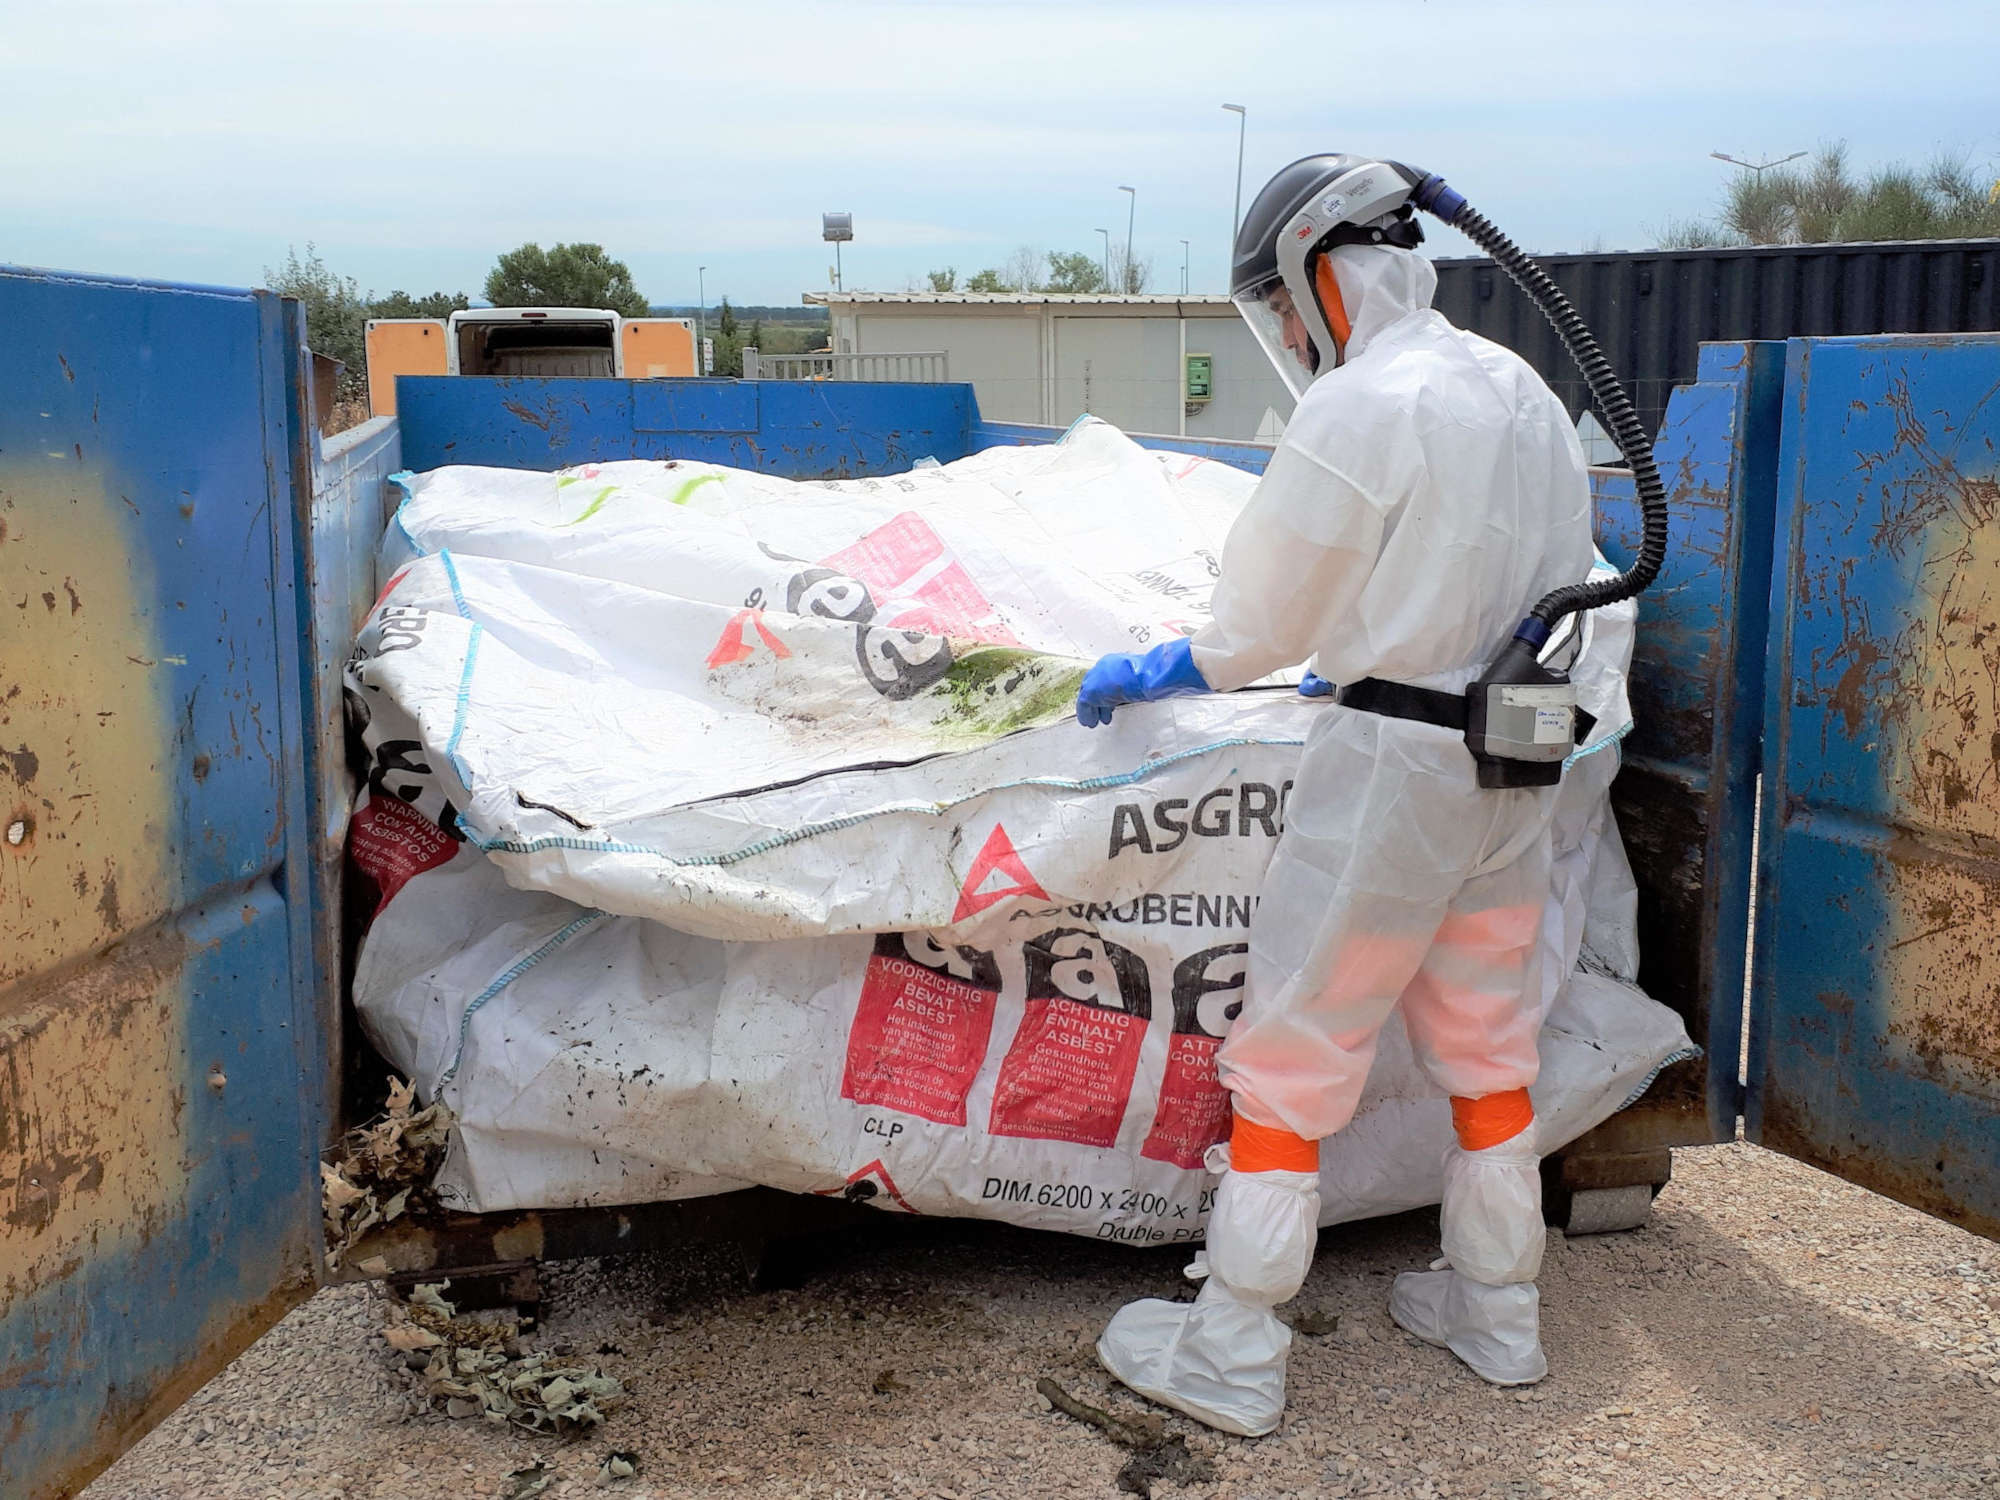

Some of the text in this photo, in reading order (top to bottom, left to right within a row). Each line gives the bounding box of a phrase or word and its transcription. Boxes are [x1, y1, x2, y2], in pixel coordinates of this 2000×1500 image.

[1107, 779, 1293, 860] ASGR
[881, 958, 983, 1003] VOORZICHTIG
[893, 996, 957, 1026] ASBEST
[904, 982, 956, 1011] BEVAT
[1045, 1012, 1127, 1043] ENTHALT
[1045, 1029, 1117, 1057] ASBEST
[863, 1116, 904, 1139] CLP
[982, 1177, 1093, 1210] DIM.6200
